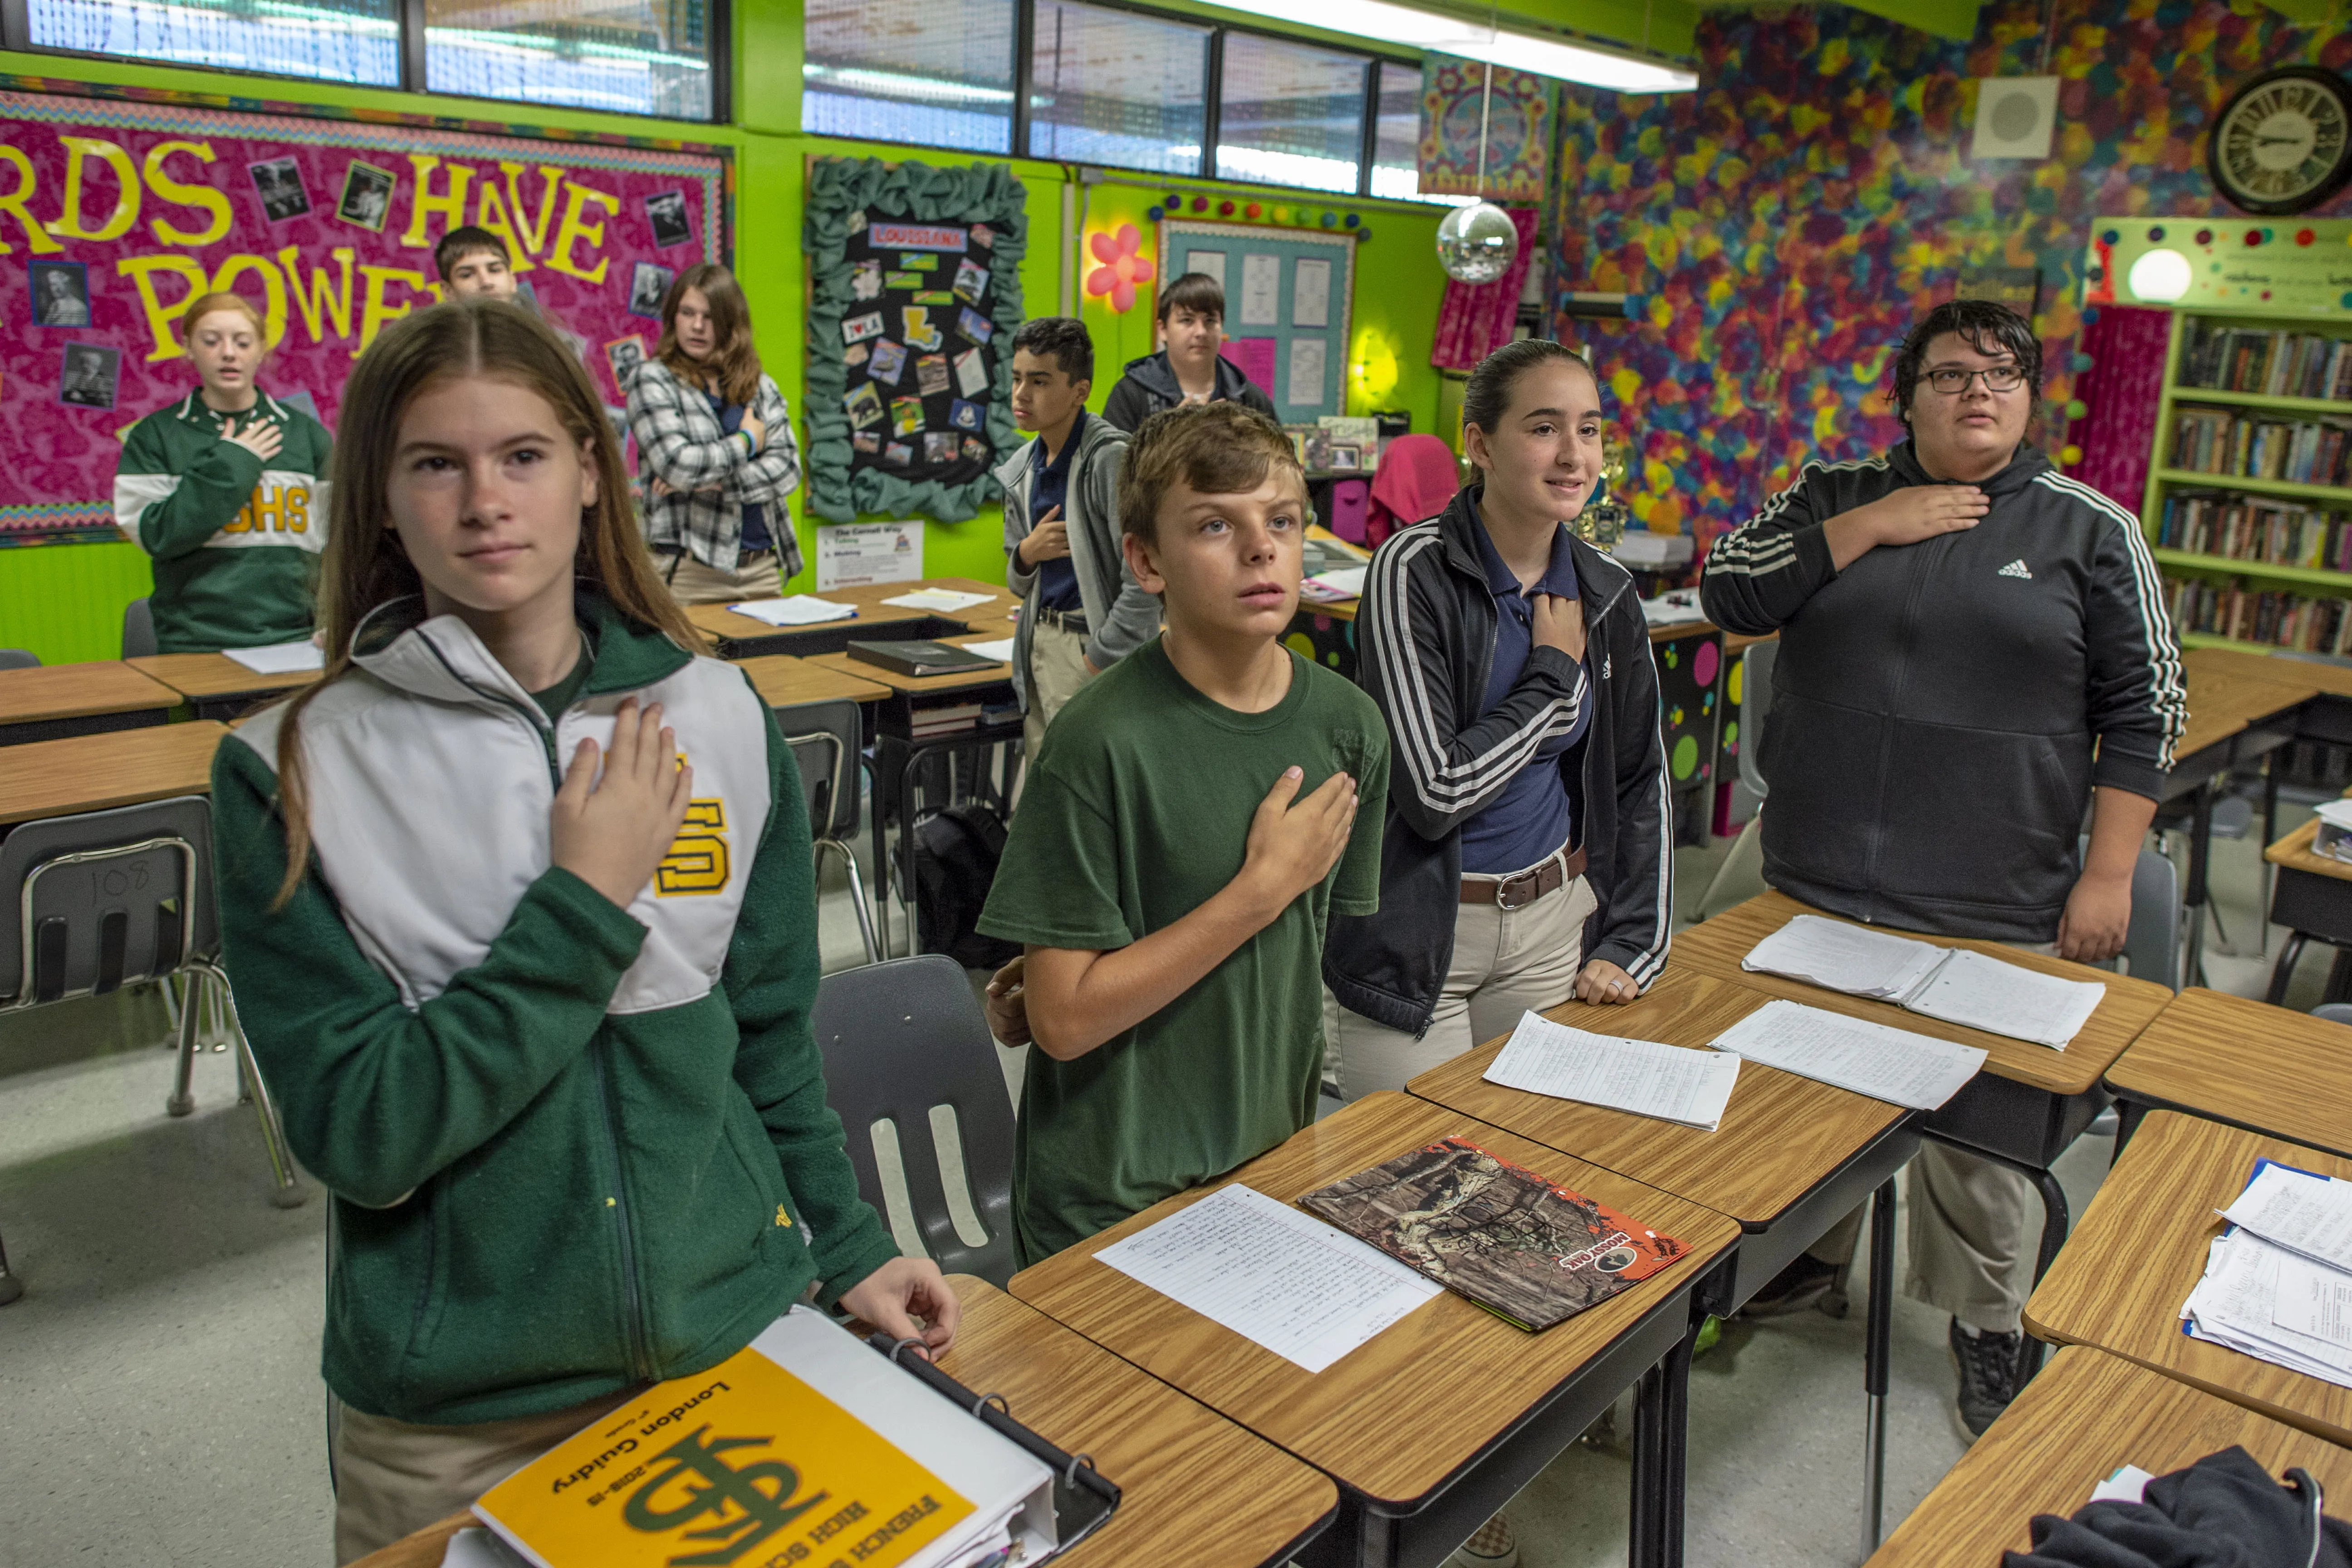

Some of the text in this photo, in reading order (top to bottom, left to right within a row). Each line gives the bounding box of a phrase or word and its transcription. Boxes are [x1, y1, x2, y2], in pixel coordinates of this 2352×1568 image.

[401, 155, 619, 284] HAVE
[873, 226, 961, 247] LOUISIANA
[1998, 568, 2032, 579] adidas
[1566, 1253, 1592, 1269] OAK
[1589, 1233, 1629, 1258] MOSSY
[552, 1381, 731, 1494] London Guidry
[807, 1500, 871, 1546] HIGH
[848, 1494, 943, 1562] FRENCH
